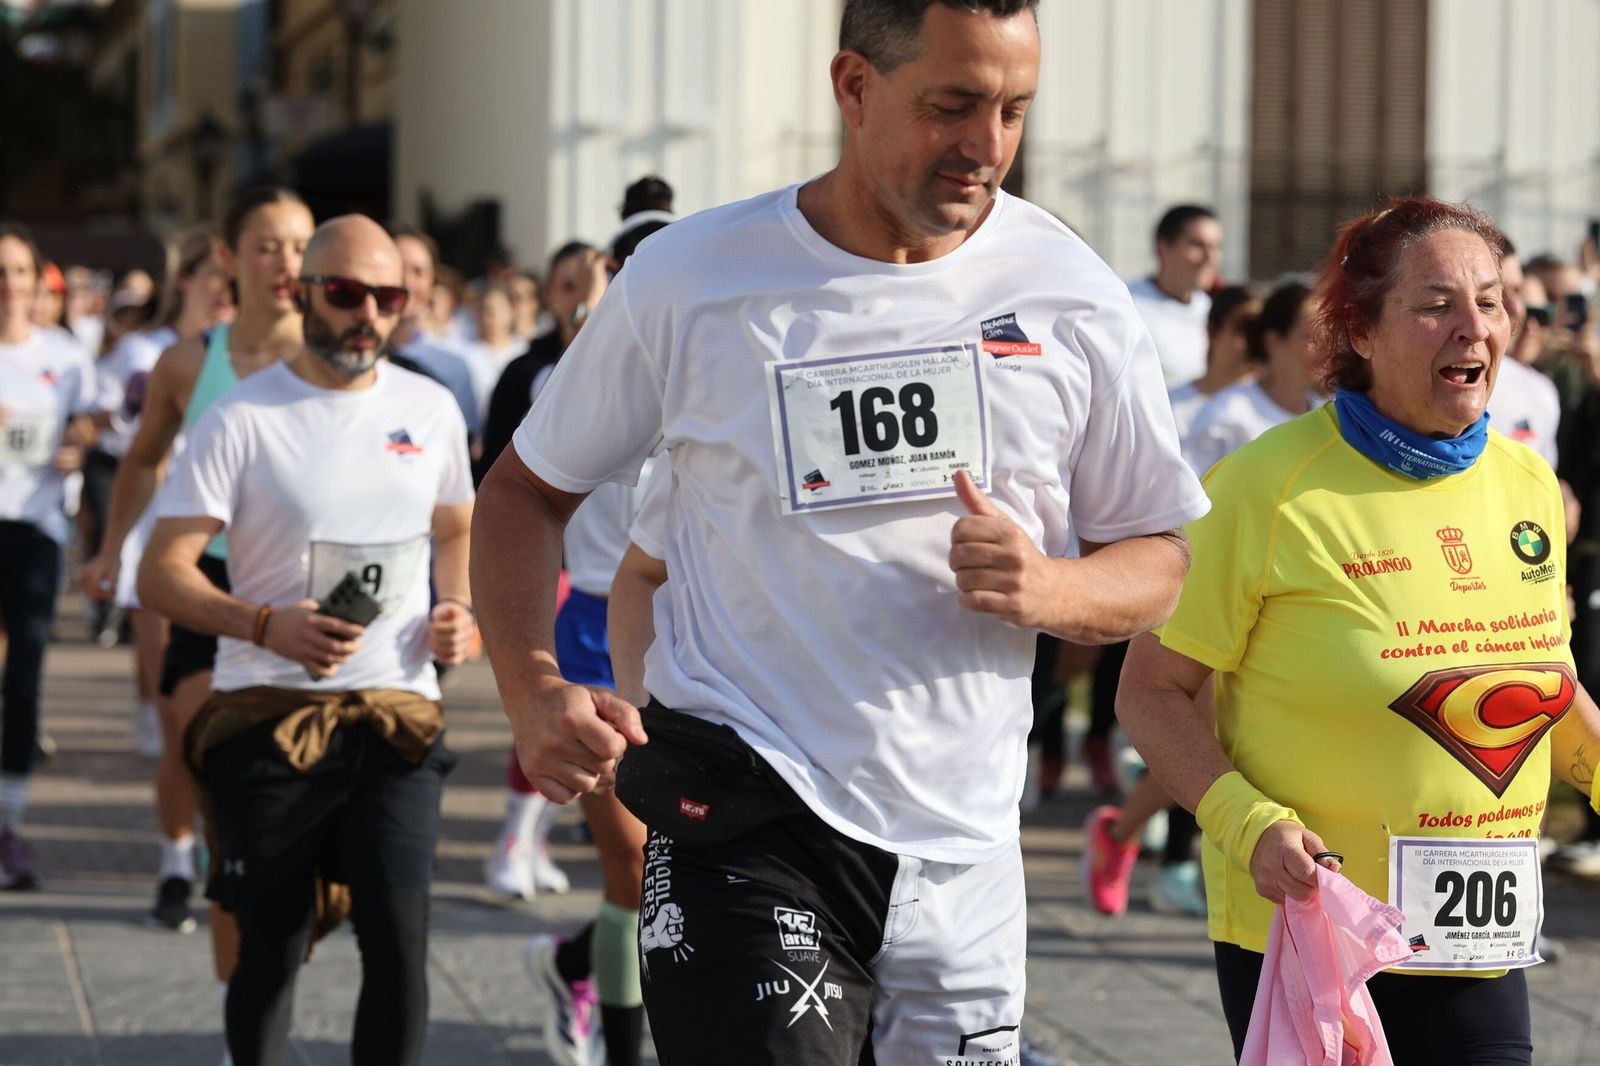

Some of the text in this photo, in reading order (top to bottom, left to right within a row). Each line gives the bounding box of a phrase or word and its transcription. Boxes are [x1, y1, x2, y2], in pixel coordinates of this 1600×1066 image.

[982, 315, 1015, 331] McArthur
[983, 328, 1003, 340] Glen
[806, 366, 847, 379] CARRERA
[850, 359, 920, 373] MCARTHURGLEN
[807, 365, 952, 389] DÍA INTERNACIONAL DE LA MUJER
[830, 382, 939, 456] 168
[849, 449, 956, 470] GOMEZ MUÑOZ, JUAN RAMÓN
[1511, 522, 1542, 541] BMW
[1352, 548, 1394, 560] Desde 1820
[1342, 556, 1412, 579] PROLONGO
[1396, 608, 1557, 637] II Marcha solidaria
[1380, 642, 1447, 660] contra
[1452, 639, 1469, 653] el
[1475, 638, 1526, 653] cáncer
[1437, 669, 1563, 749] C
[1417, 811, 1473, 828] Todos
[1477, 804, 1533, 828] podemos
[1423, 849, 1458, 857] CARRERA
[1460, 849, 1508, 858] MCARTHURGLEN
[1423, 857, 1436, 866] DÍA
[1438, 858, 1491, 867] INTERNACIONAL
[1492, 859, 1500, 867] DE
[1509, 858, 1525, 866] MUJER
[1434, 870, 1517, 927] 206
[784, 933, 814, 946] arte
[1445, 930, 1521, 940] JIMÉNEZ GARCÍA, INMACULADA
[786, 951, 820, 963] SUAVE
[756, 979, 843, 1001] JIU JITSU
